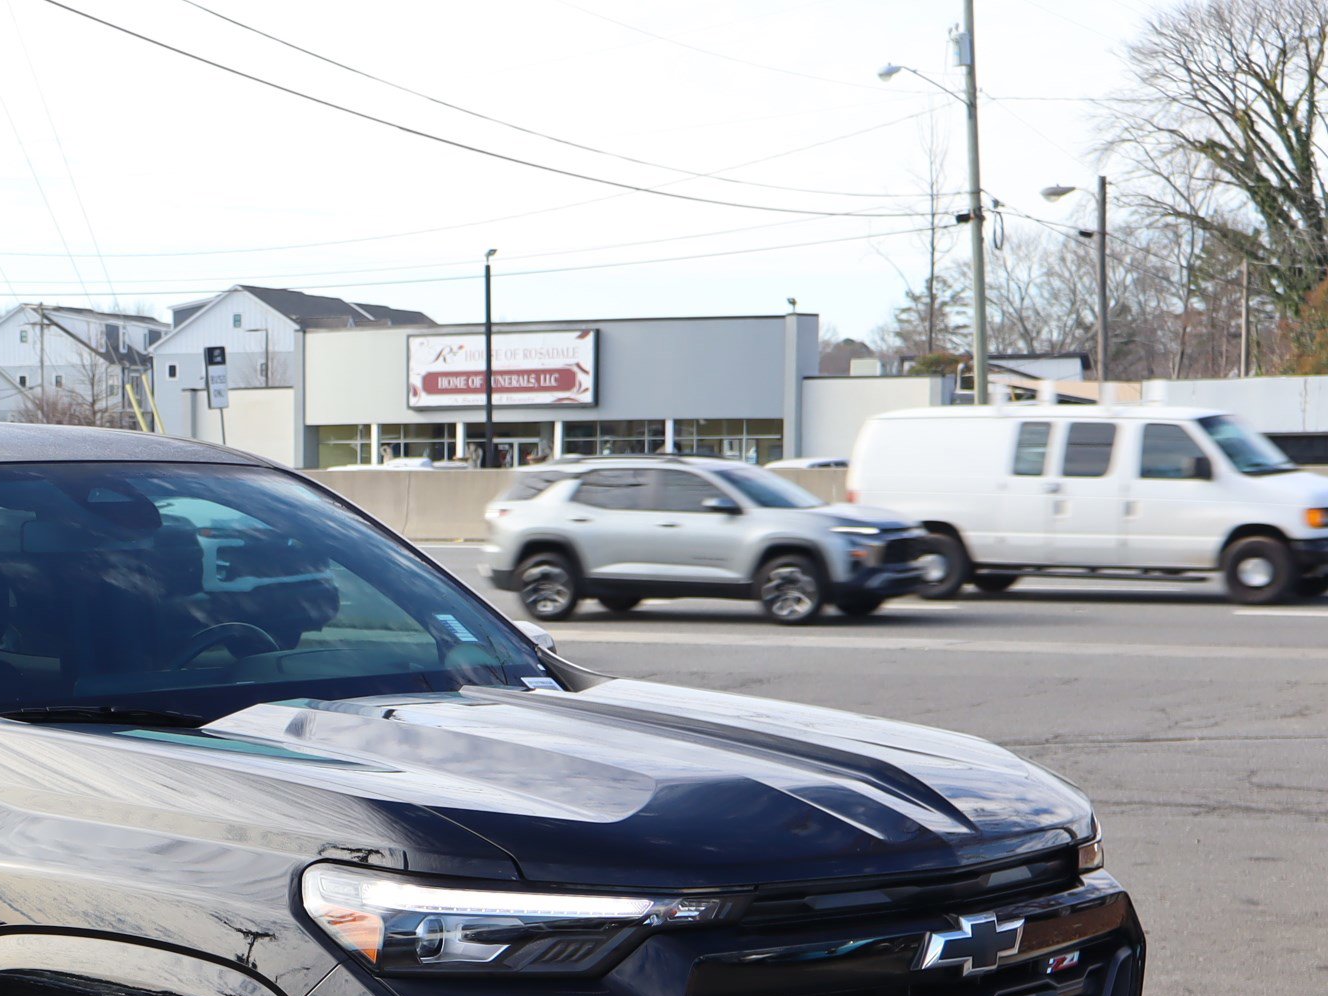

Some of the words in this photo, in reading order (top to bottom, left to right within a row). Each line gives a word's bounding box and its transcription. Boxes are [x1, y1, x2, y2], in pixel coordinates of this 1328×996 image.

[504, 349, 520, 361] OF
[522, 347, 580, 360] ROSADALE
[438, 375, 468, 389] HOME
[468, 375, 483, 389] OF
[488, 373, 538, 389] UNERALS,
[540, 373, 559, 387] LLC
